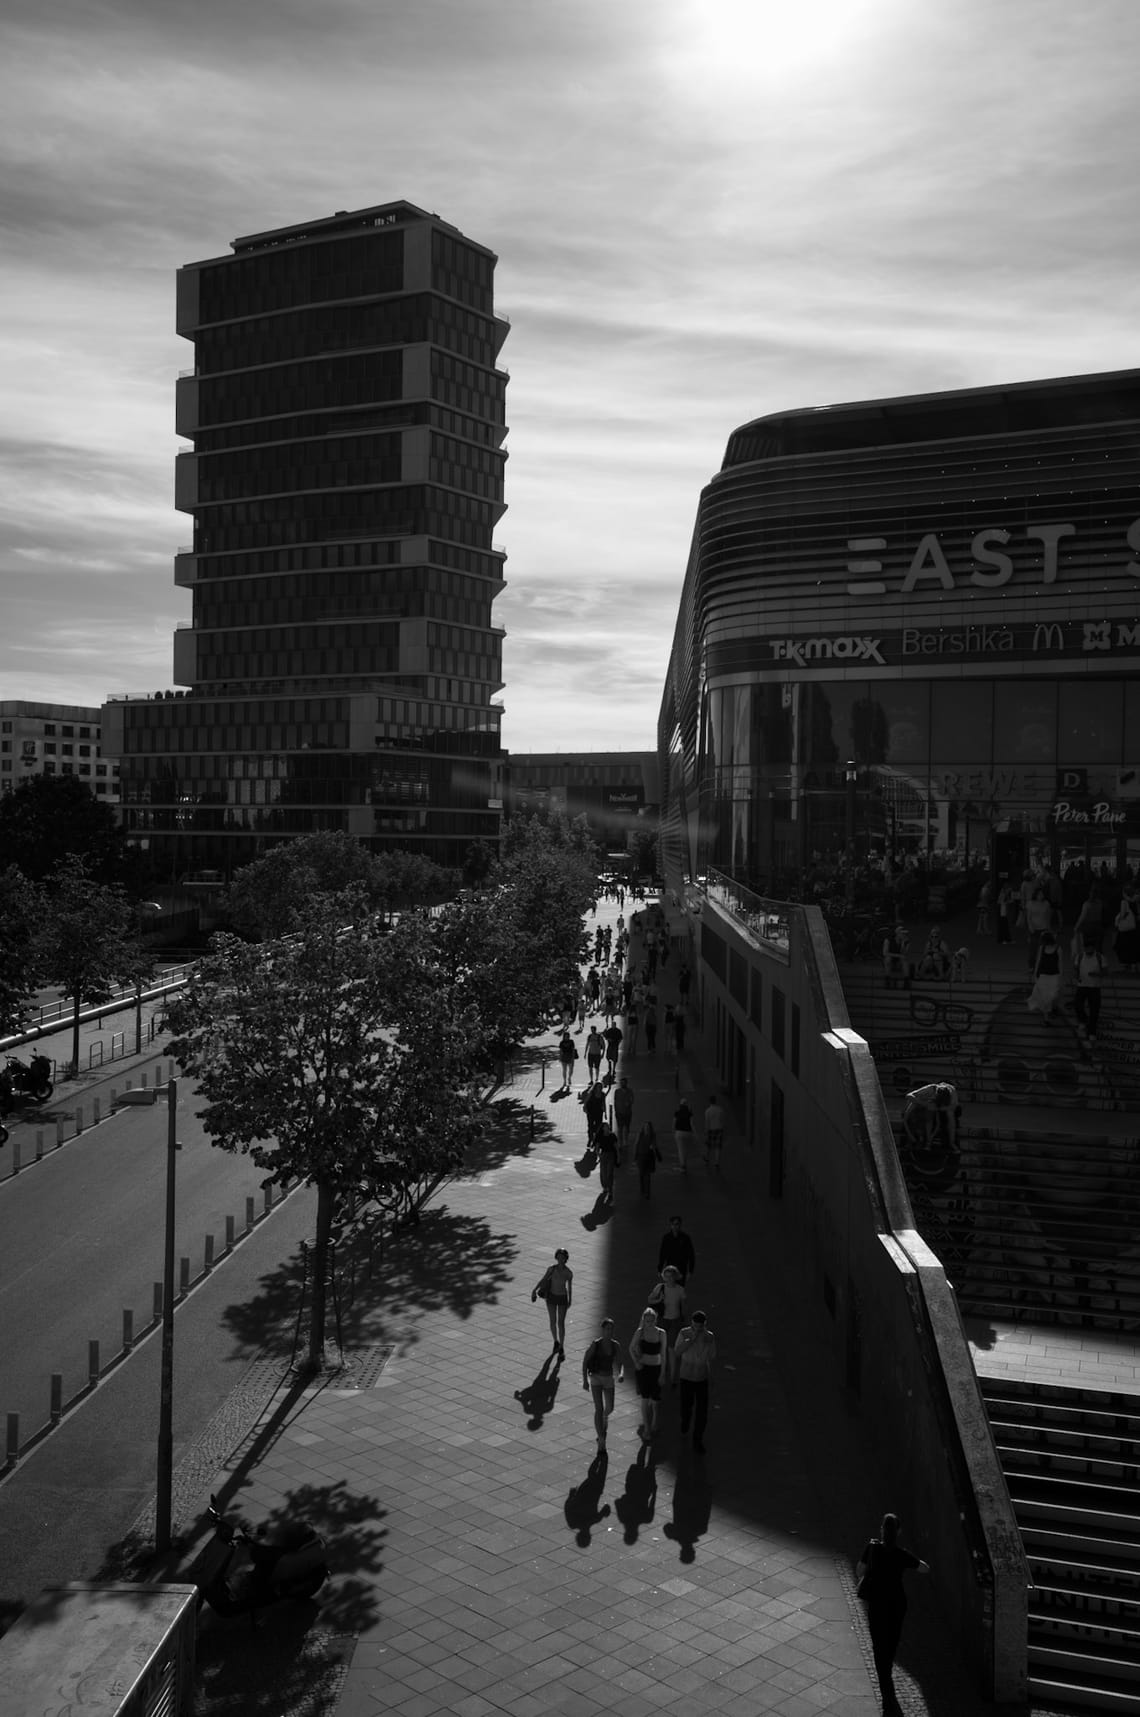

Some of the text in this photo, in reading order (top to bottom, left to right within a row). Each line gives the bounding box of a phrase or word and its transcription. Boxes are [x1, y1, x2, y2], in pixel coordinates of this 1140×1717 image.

[847, 523, 1077, 594] EAST
[902, 628, 1015, 655] Bershka
[940, 770, 1036, 797] REWE
[1052, 802, 1127, 827] Peter Pane
